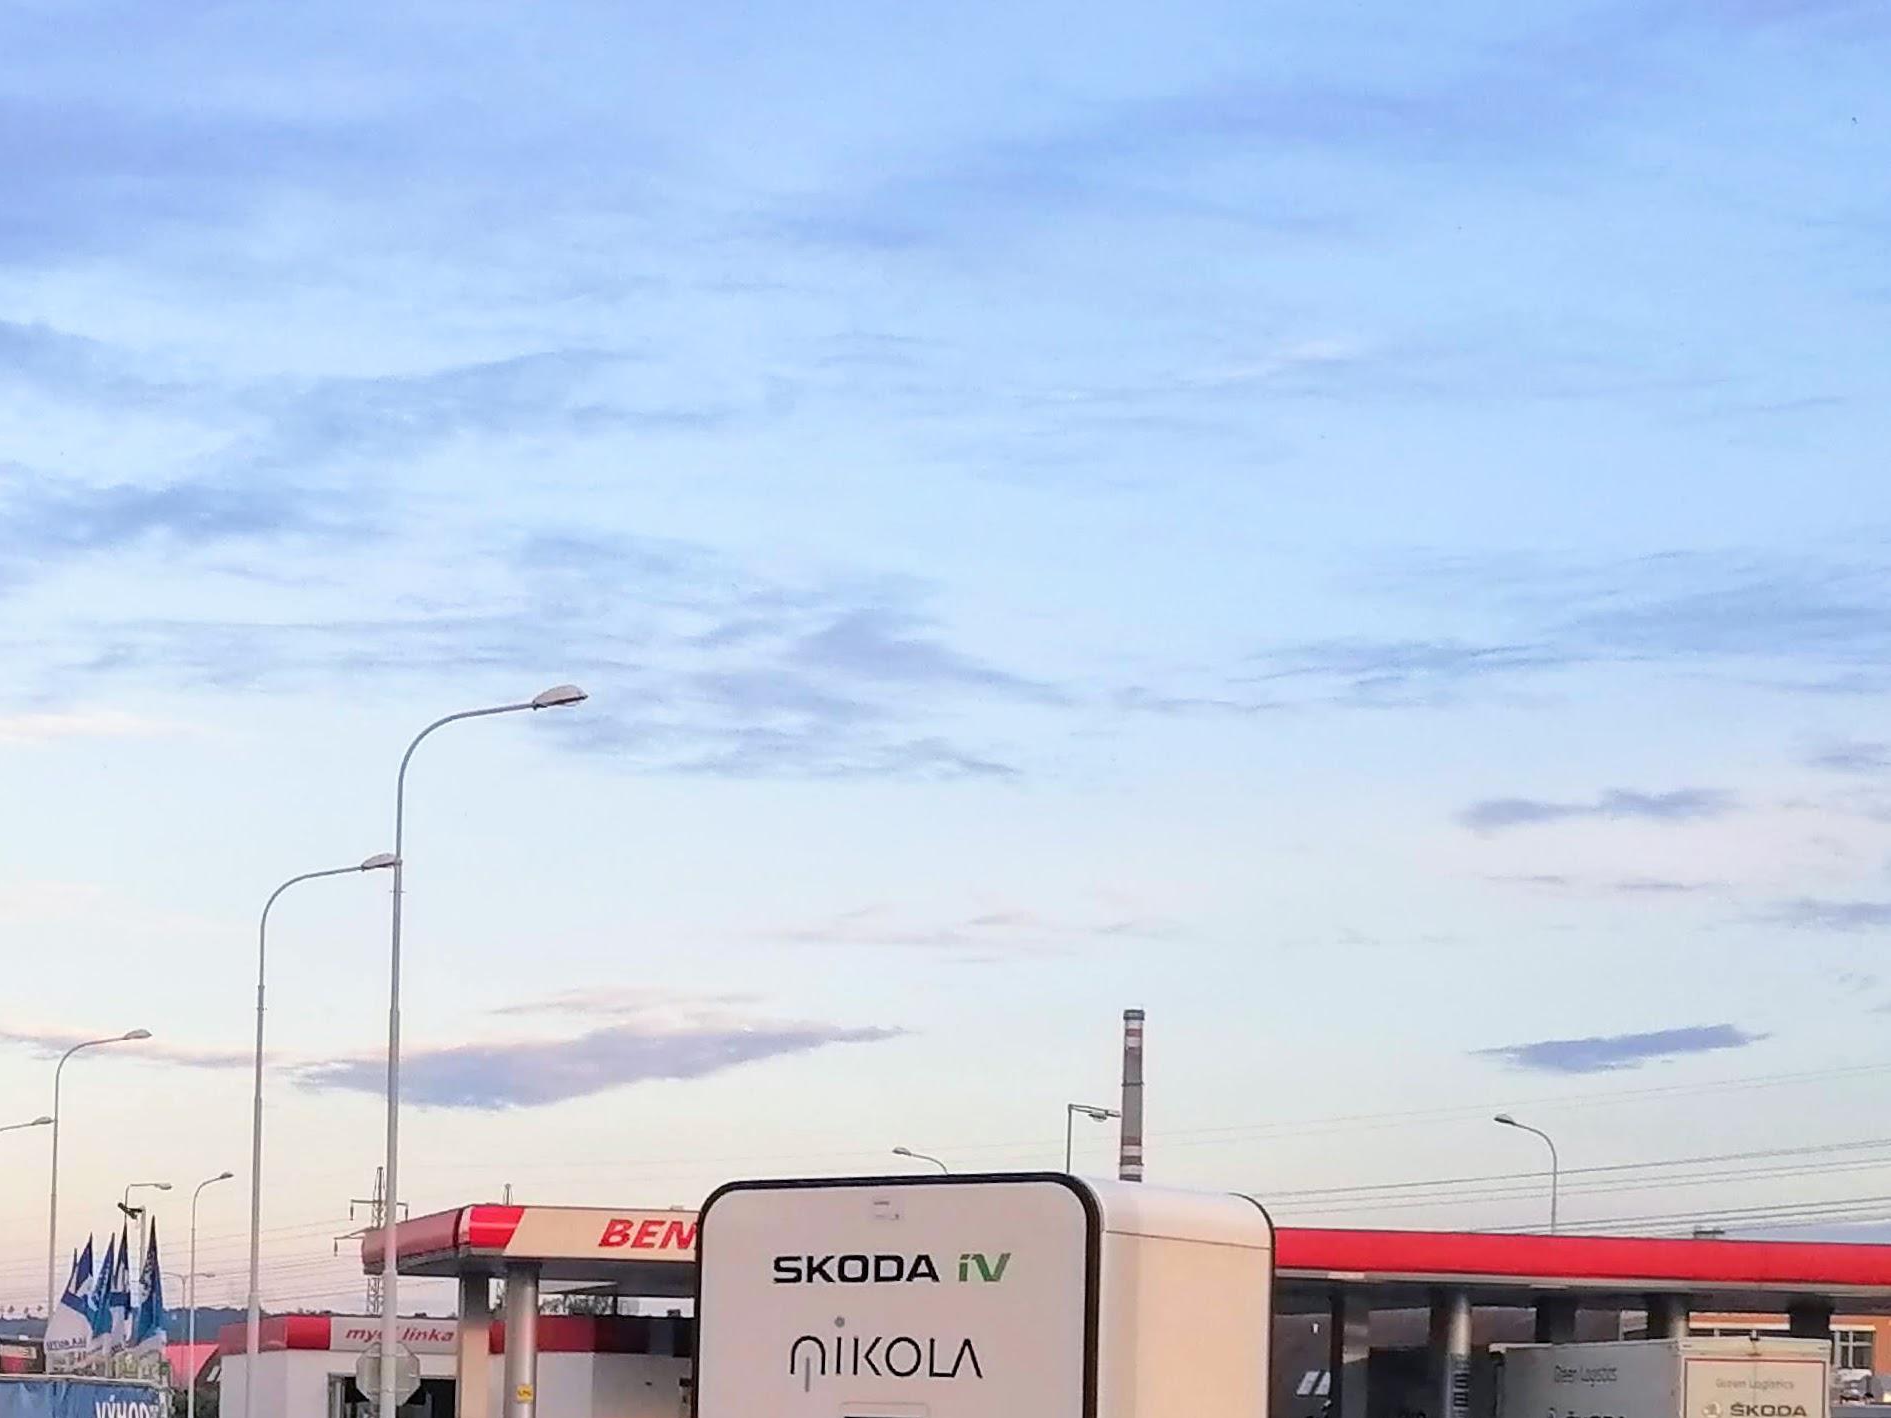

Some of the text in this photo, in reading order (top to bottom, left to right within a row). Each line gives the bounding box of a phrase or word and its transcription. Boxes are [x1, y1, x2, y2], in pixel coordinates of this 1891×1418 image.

[773, 1252, 1011, 1283] SKODA iV
[402, 1327, 454, 1342] linka
[790, 1316, 983, 1391] NIKOLA
[1730, 1401, 1807, 1417] ŠKODA
